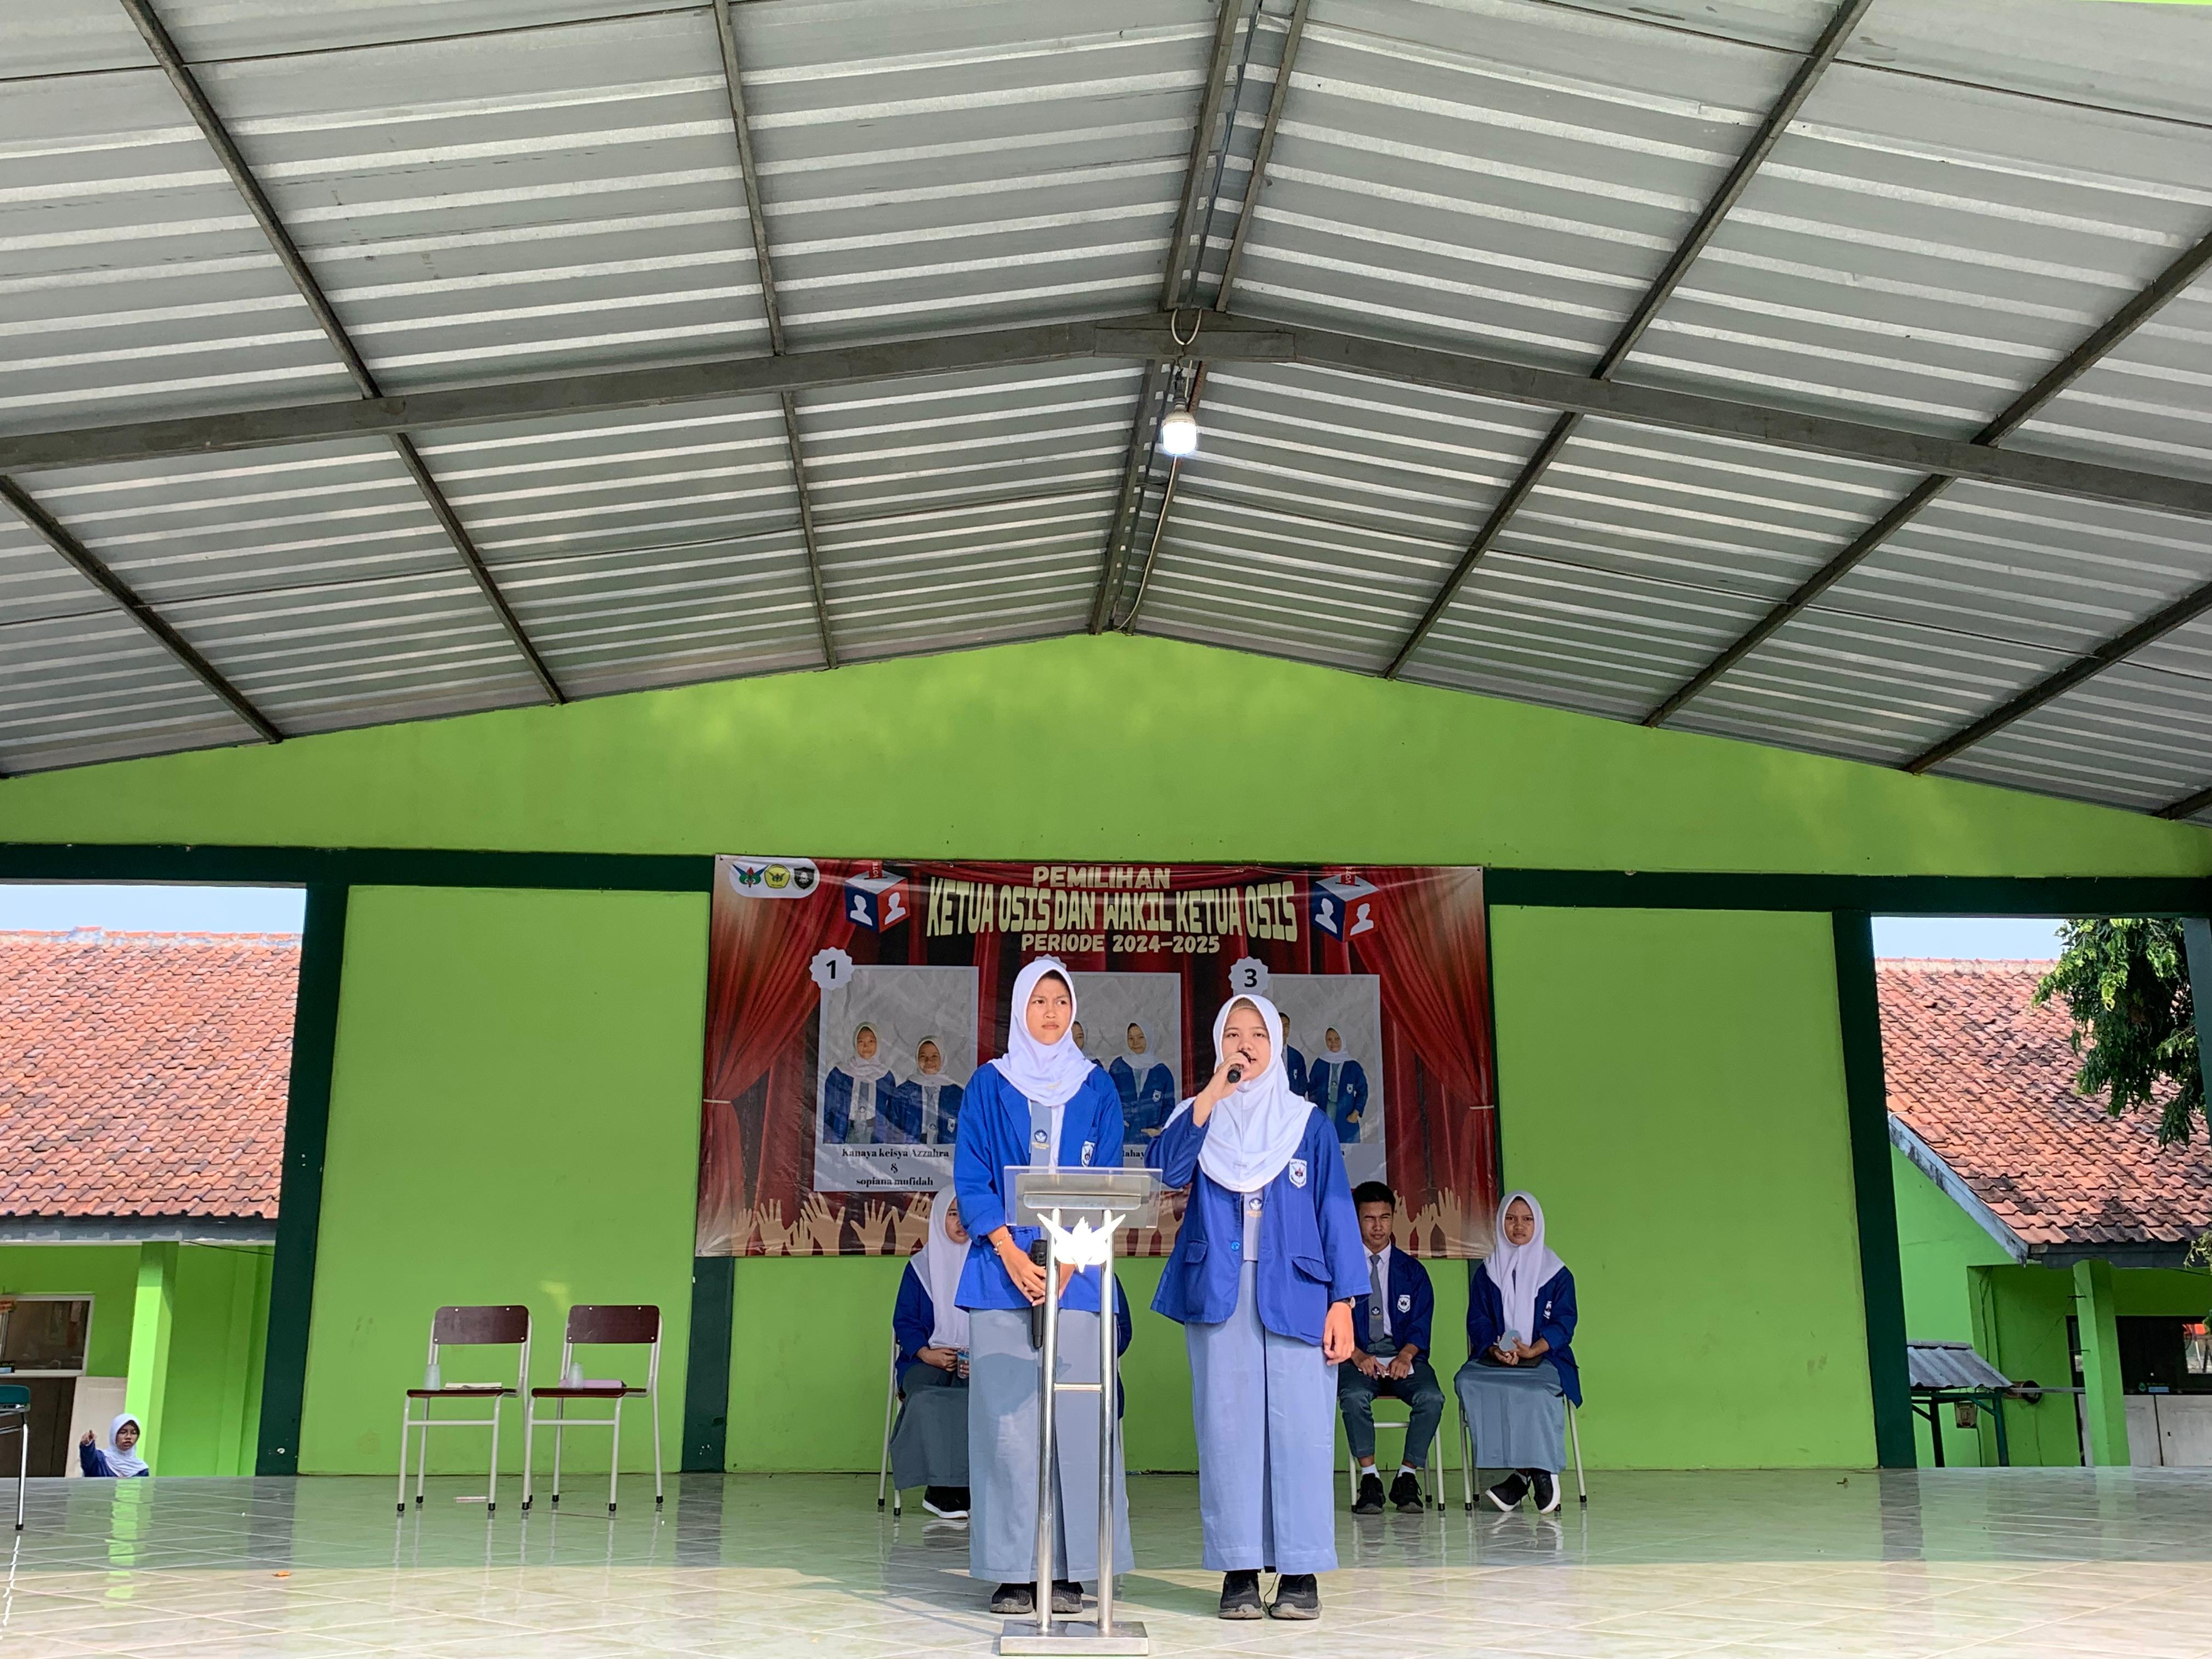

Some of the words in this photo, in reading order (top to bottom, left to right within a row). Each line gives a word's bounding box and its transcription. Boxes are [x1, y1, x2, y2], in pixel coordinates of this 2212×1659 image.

[1033, 866, 1170, 889] PEMILIHAN
[927, 877, 994, 936] KETUA
[998, 885, 1051, 932] OSIS
[1054, 890, 1096, 930] DAN
[1103, 892, 1172, 932] WAKIL
[1176, 888, 1243, 936] KETUA
[1245, 881, 1297, 942] OSIS
[1022, 934, 1105, 952] PERIODE
[1113, 935, 1220, 953] 2024-2025
[826, 960, 836, 979] 1
[1244, 968, 1257, 988] 3
[879, 1148, 908, 1159] keisya
[856, 1177, 892, 1187] sopiana
[894, 1177, 934, 1185] mufidah
